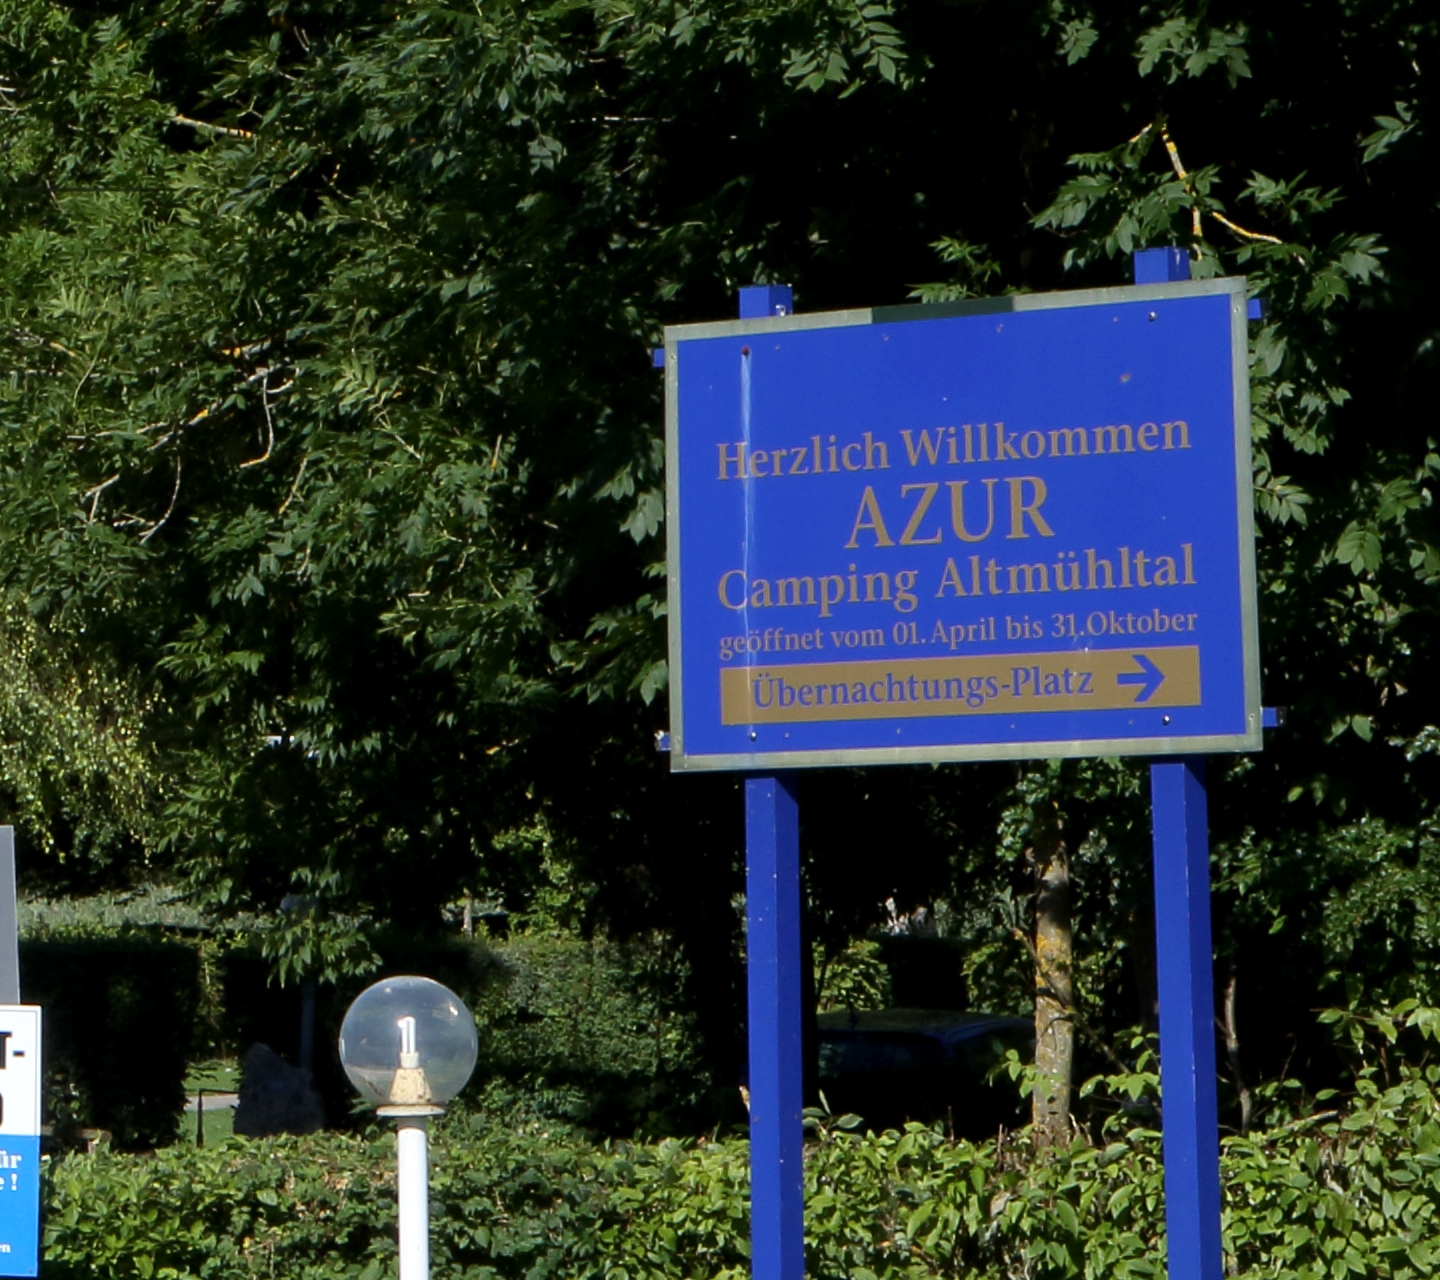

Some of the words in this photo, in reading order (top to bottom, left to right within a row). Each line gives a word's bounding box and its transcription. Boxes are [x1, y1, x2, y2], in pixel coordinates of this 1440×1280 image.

[716, 431, 891, 482] Herzlich
[900, 420, 1192, 468] Willkommen
[845, 475, 1056, 550] AZUR
[717, 563, 920, 618] Camping
[935, 543, 1197, 599] Altmühltal
[719, 628, 825, 661] geöffnet
[831, 628, 885, 648] vom
[892, 621, 927, 646] 01.
[931, 617, 996, 651] April
[1005, 616, 1045, 640] bis
[751, 666, 1095, 709] Übernachtungs-Platz
